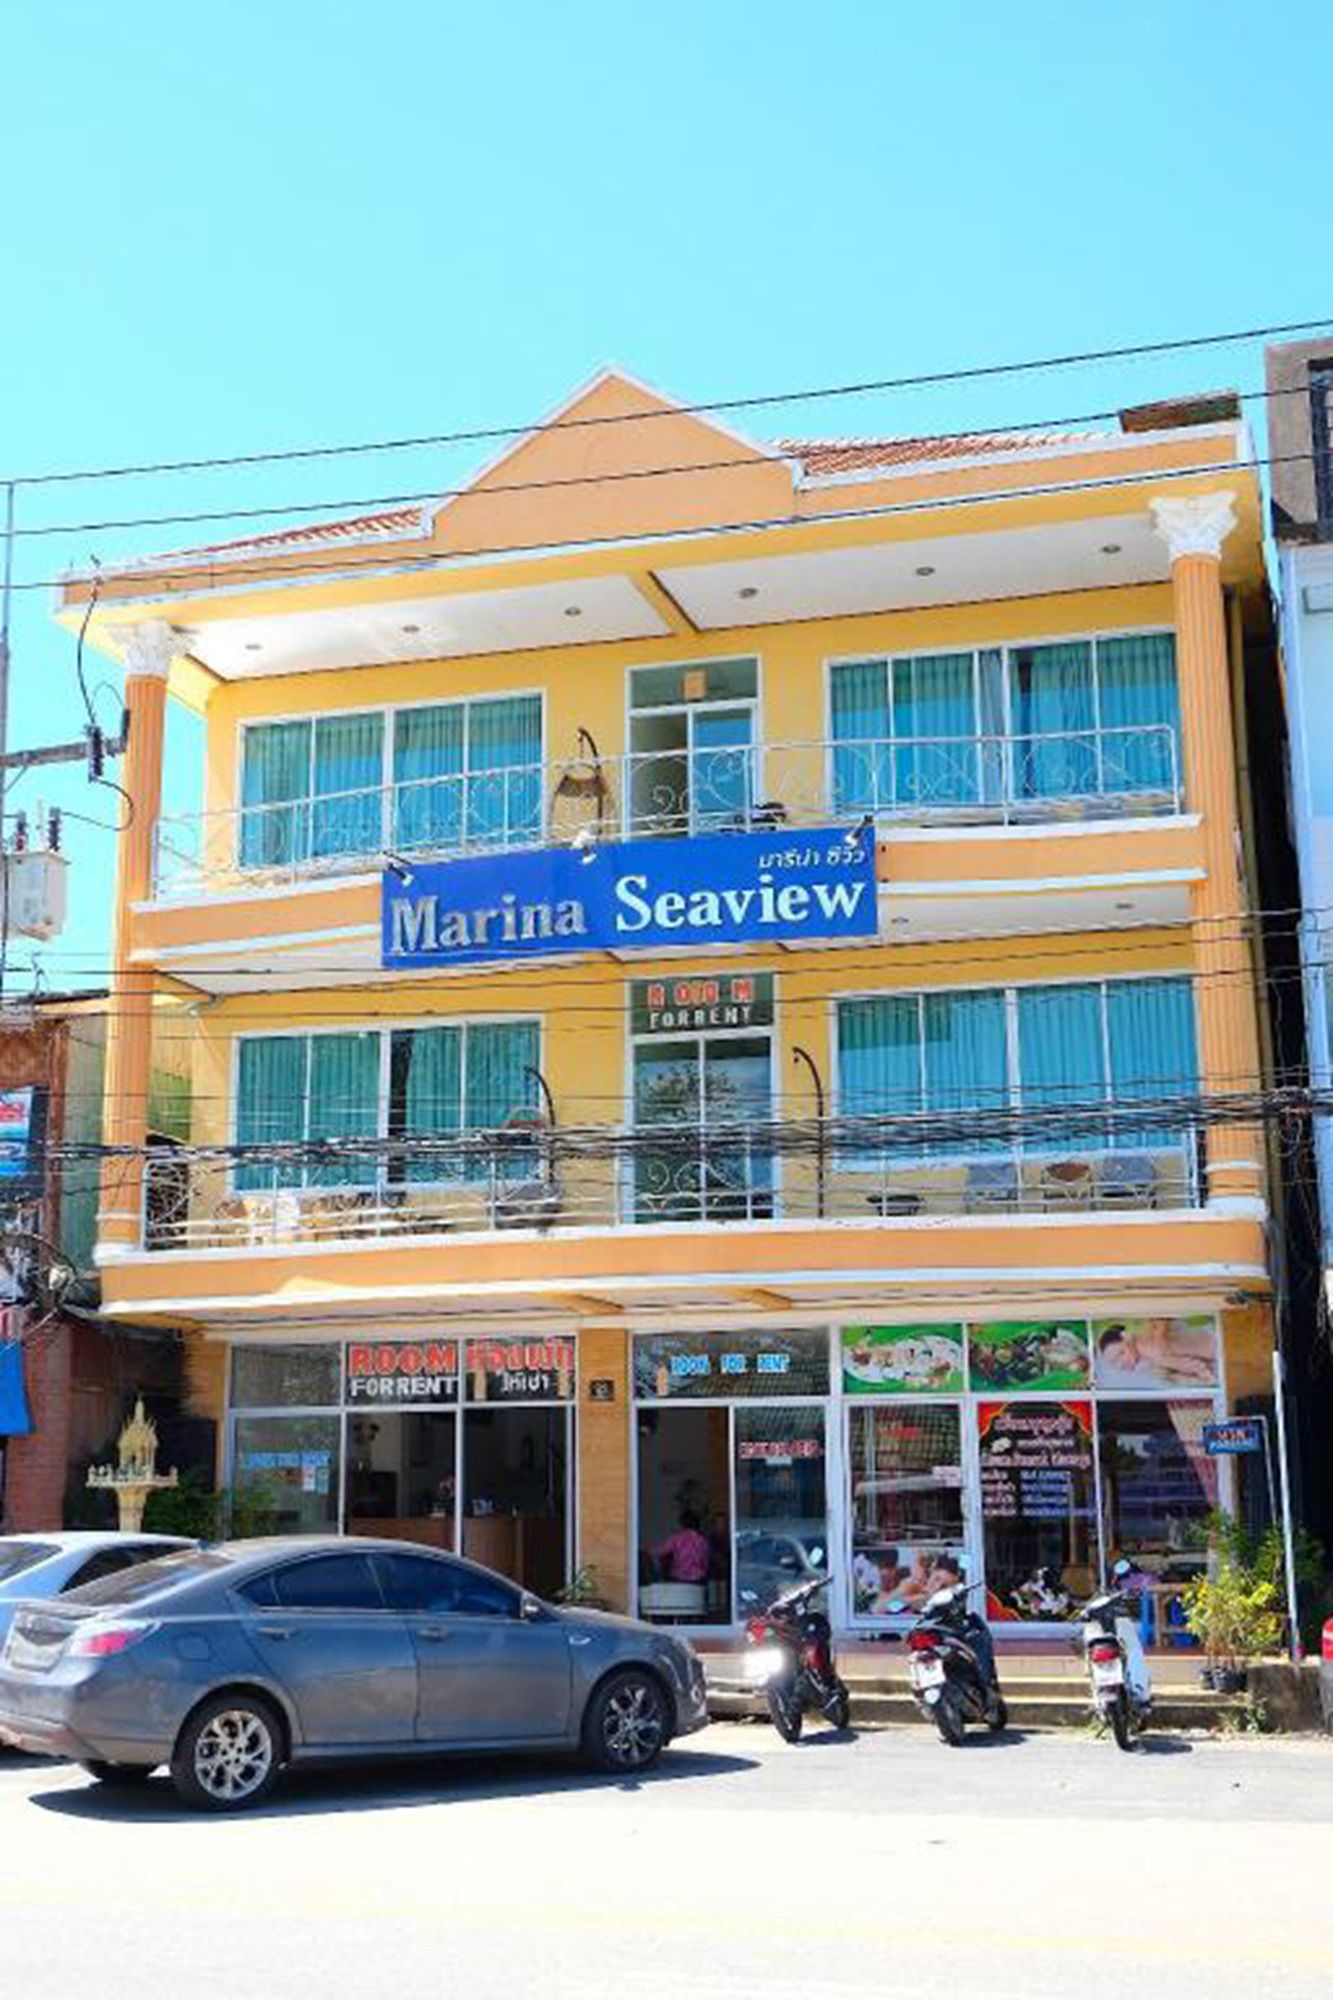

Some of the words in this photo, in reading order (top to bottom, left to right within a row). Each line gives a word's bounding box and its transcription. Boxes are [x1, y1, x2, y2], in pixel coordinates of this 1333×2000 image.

[391, 894, 588, 957] Marina
[615, 873, 866, 932] Seaview
[648, 979, 753, 1011] ROOM
[349, 1341, 456, 1377] ROOM
